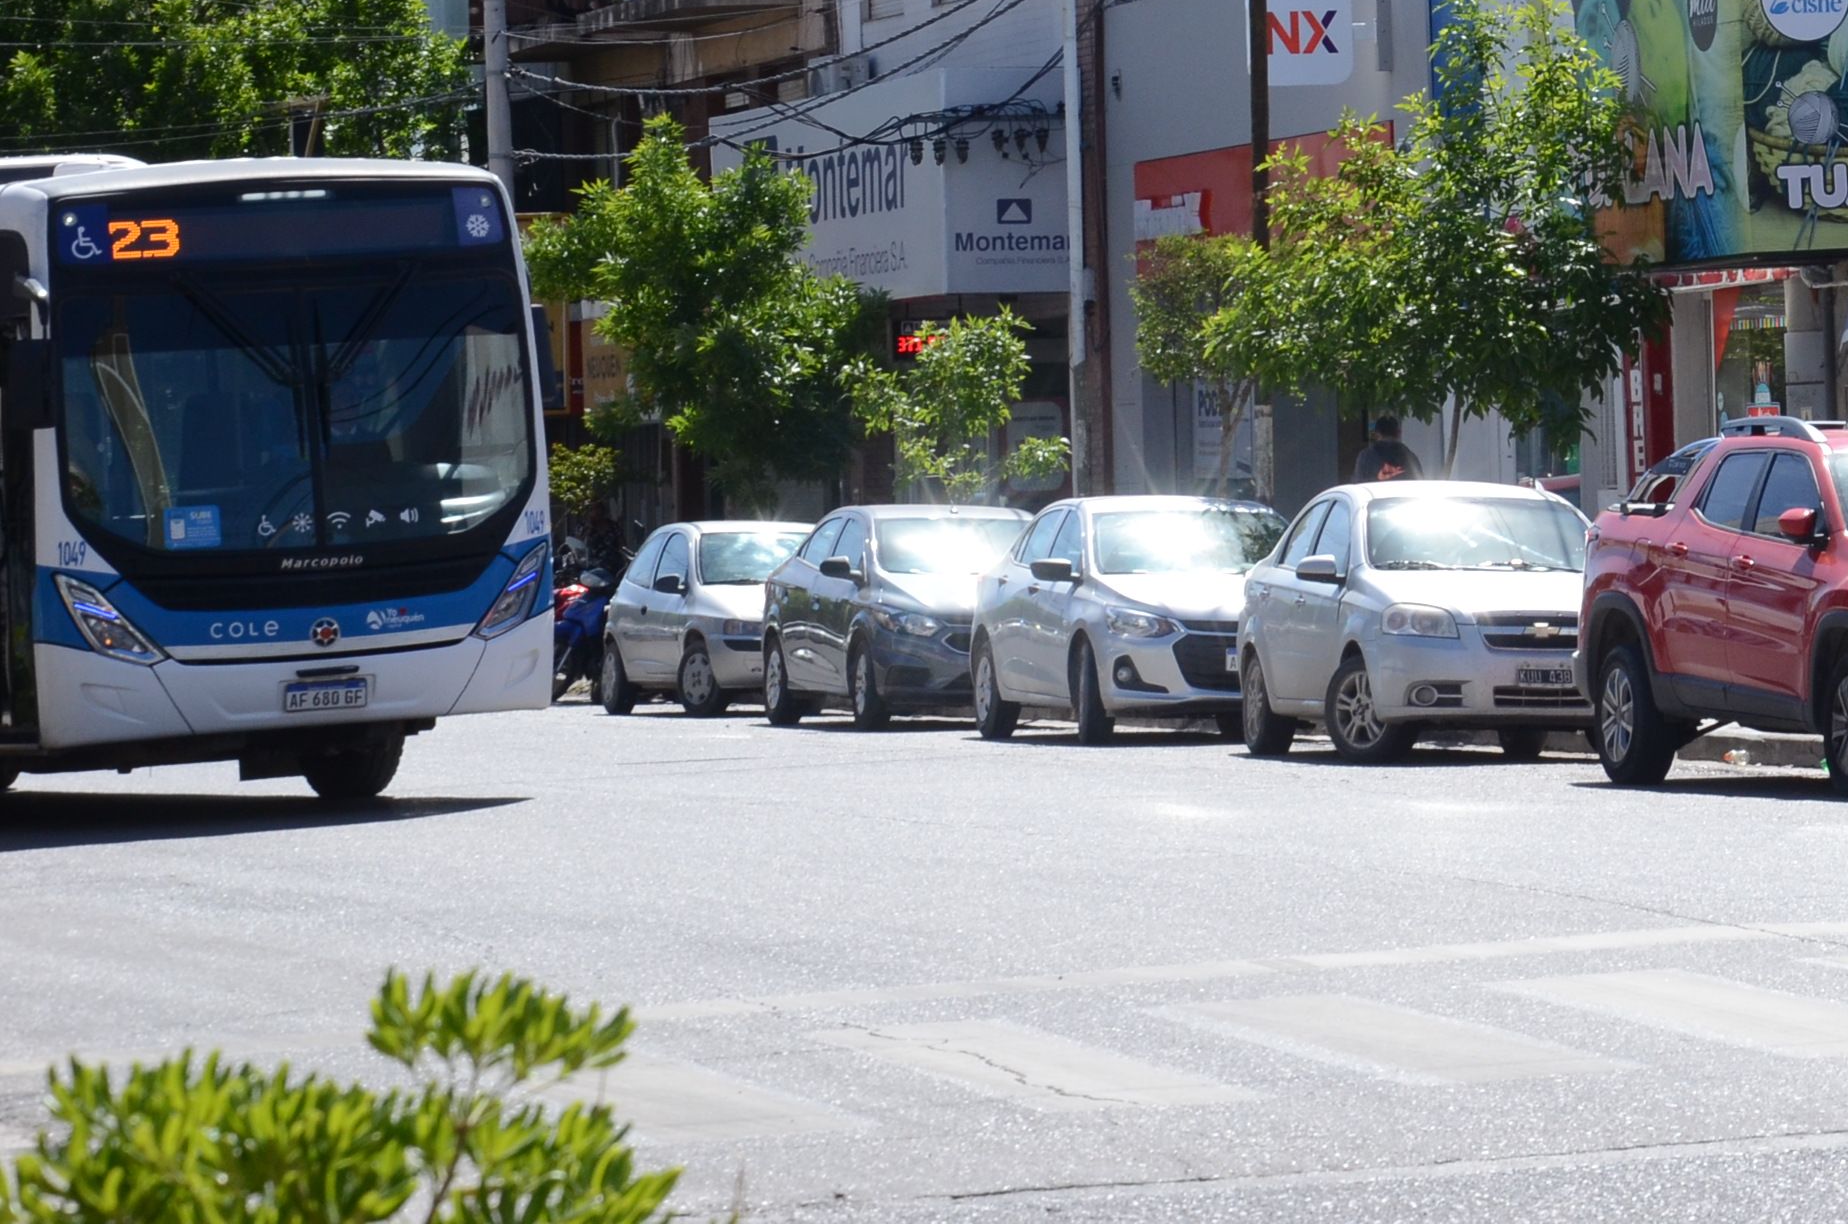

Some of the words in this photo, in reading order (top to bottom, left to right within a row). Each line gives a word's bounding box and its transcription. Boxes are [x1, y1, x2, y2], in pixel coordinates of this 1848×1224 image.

[1266, 10, 1339, 55] NX
[108, 219, 180, 260] 23
[58, 542, 86, 566] 1049
[1550, 670, 1571, 682] 438
[290, 693, 308, 708] AF
[313, 690, 340, 707] 680
[345, 689, 364, 704] GF
